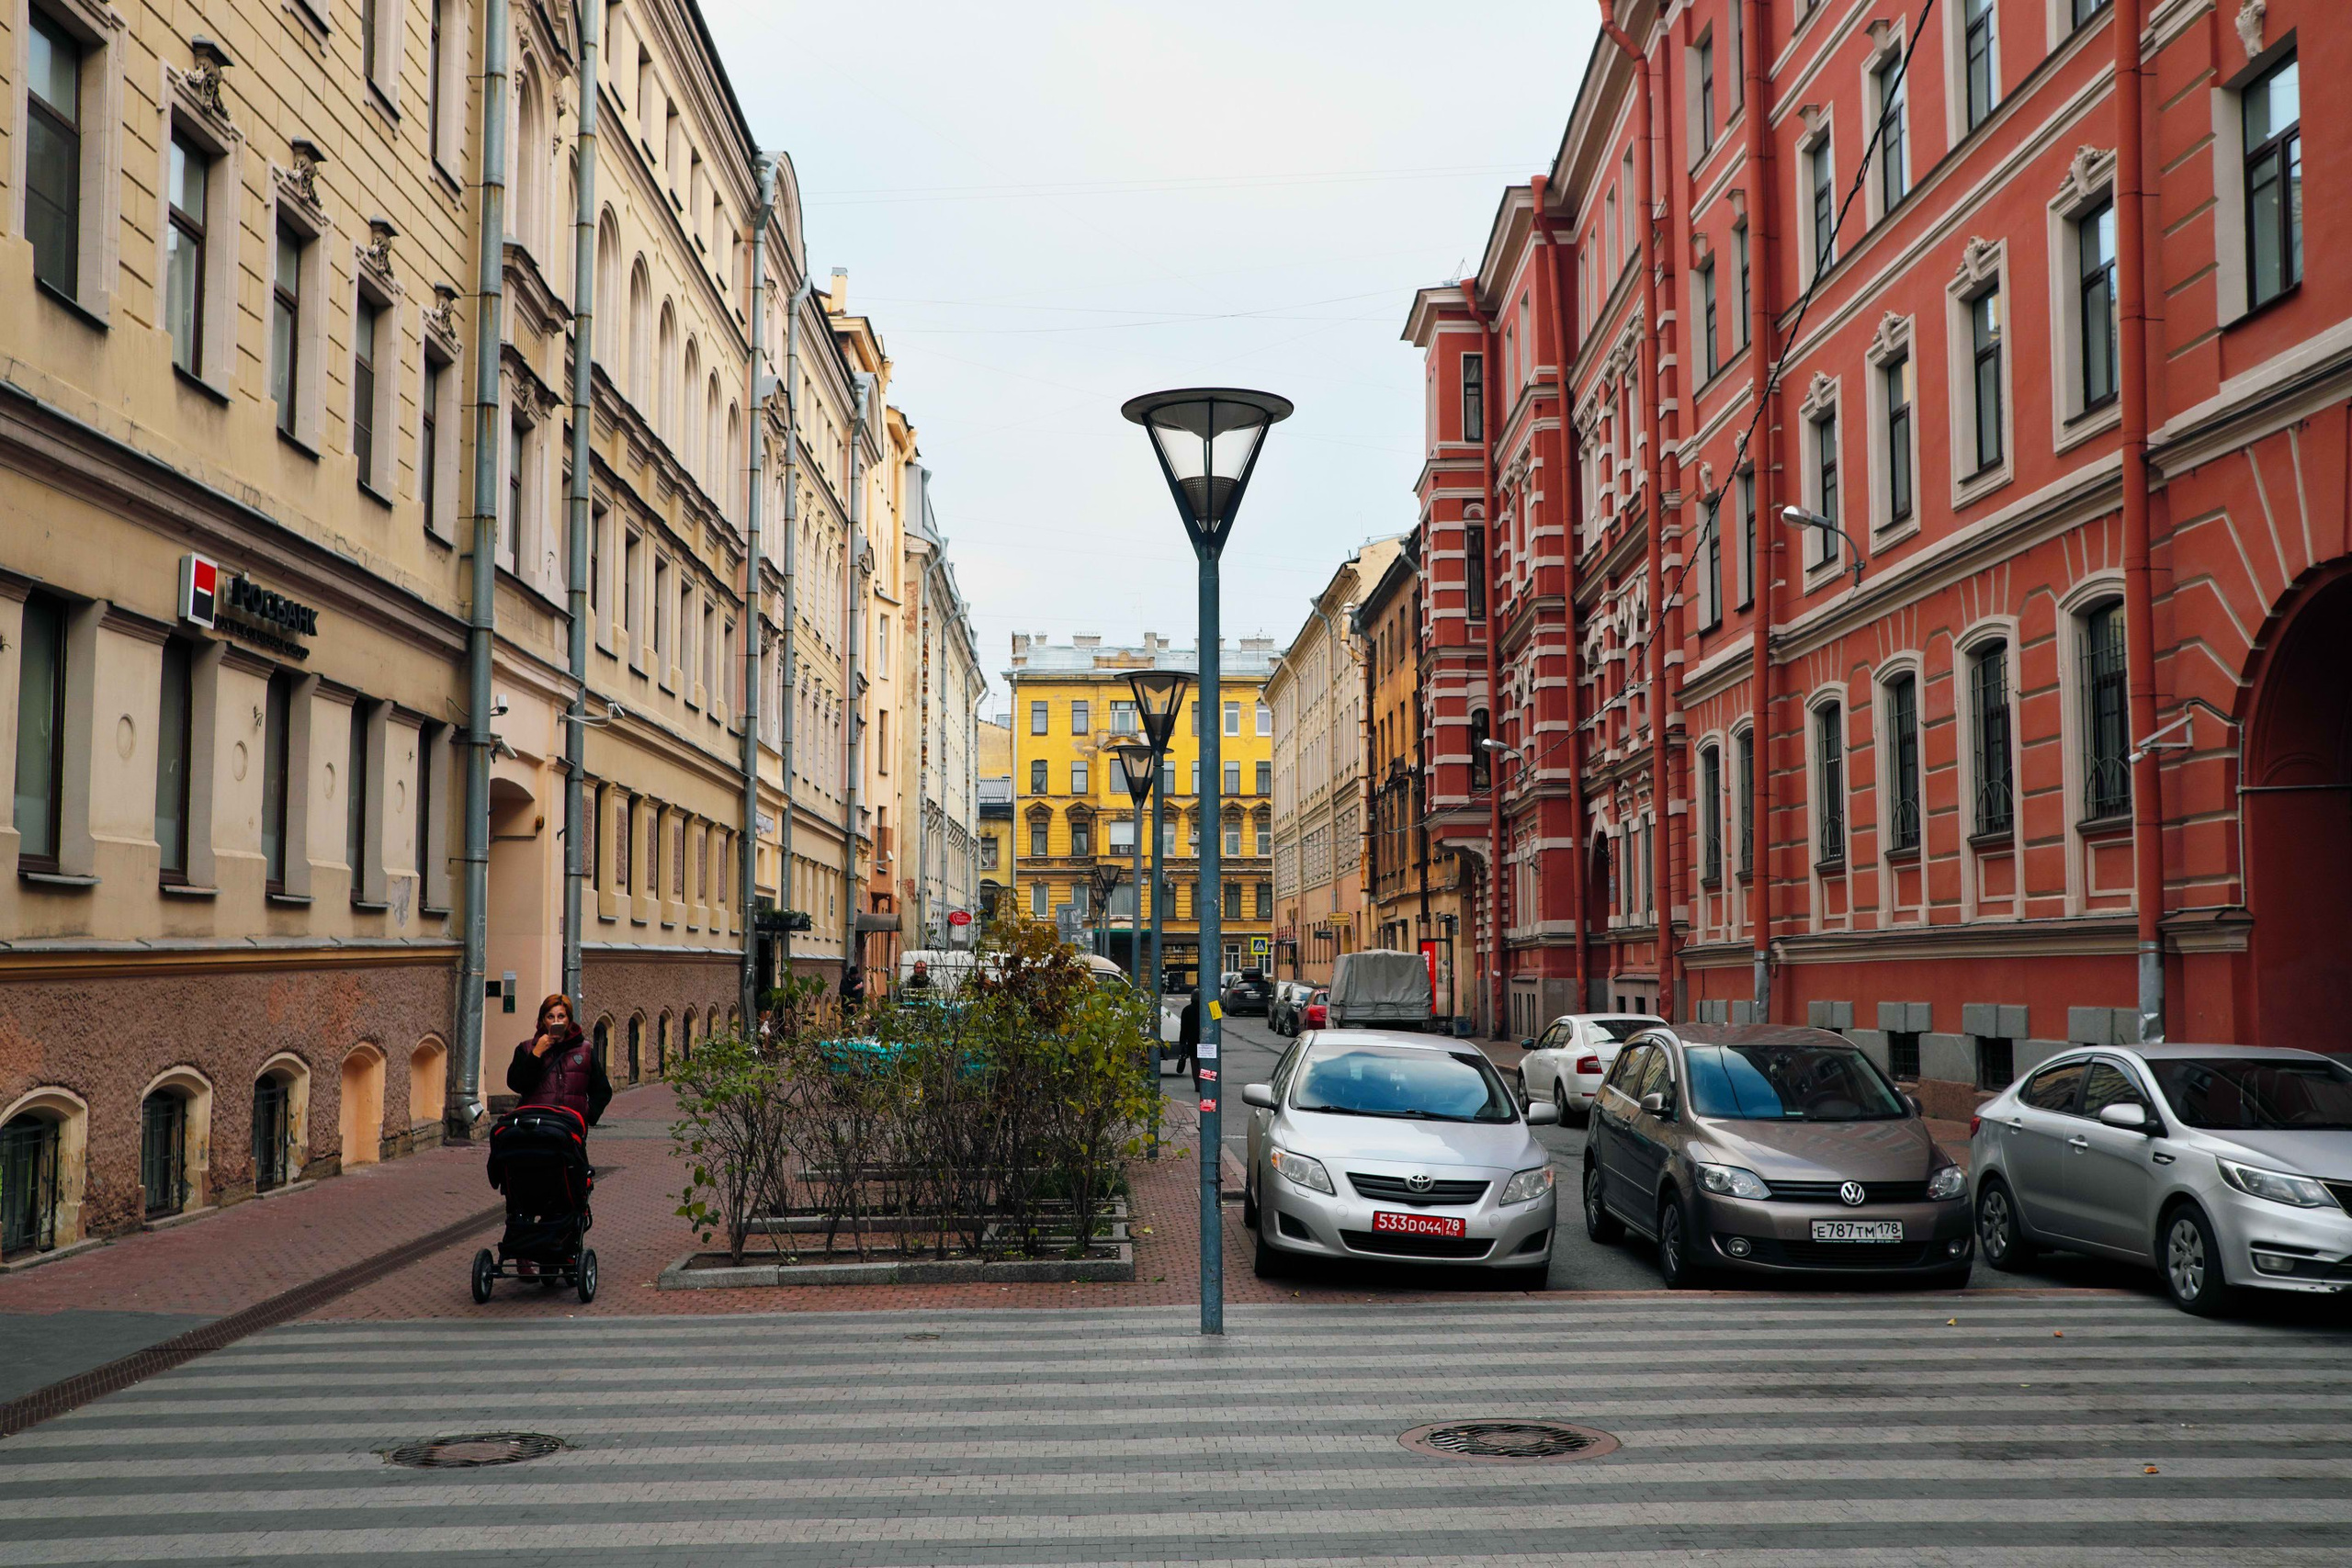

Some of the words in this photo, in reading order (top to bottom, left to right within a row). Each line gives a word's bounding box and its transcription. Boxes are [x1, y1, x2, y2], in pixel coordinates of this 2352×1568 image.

[232, 577, 319, 637] РОСБАНК
[1378, 1213, 1442, 1234] 533D044
[1445, 1219, 1460, 1231] 78
[1877, 1223, 1899, 1235] 178
